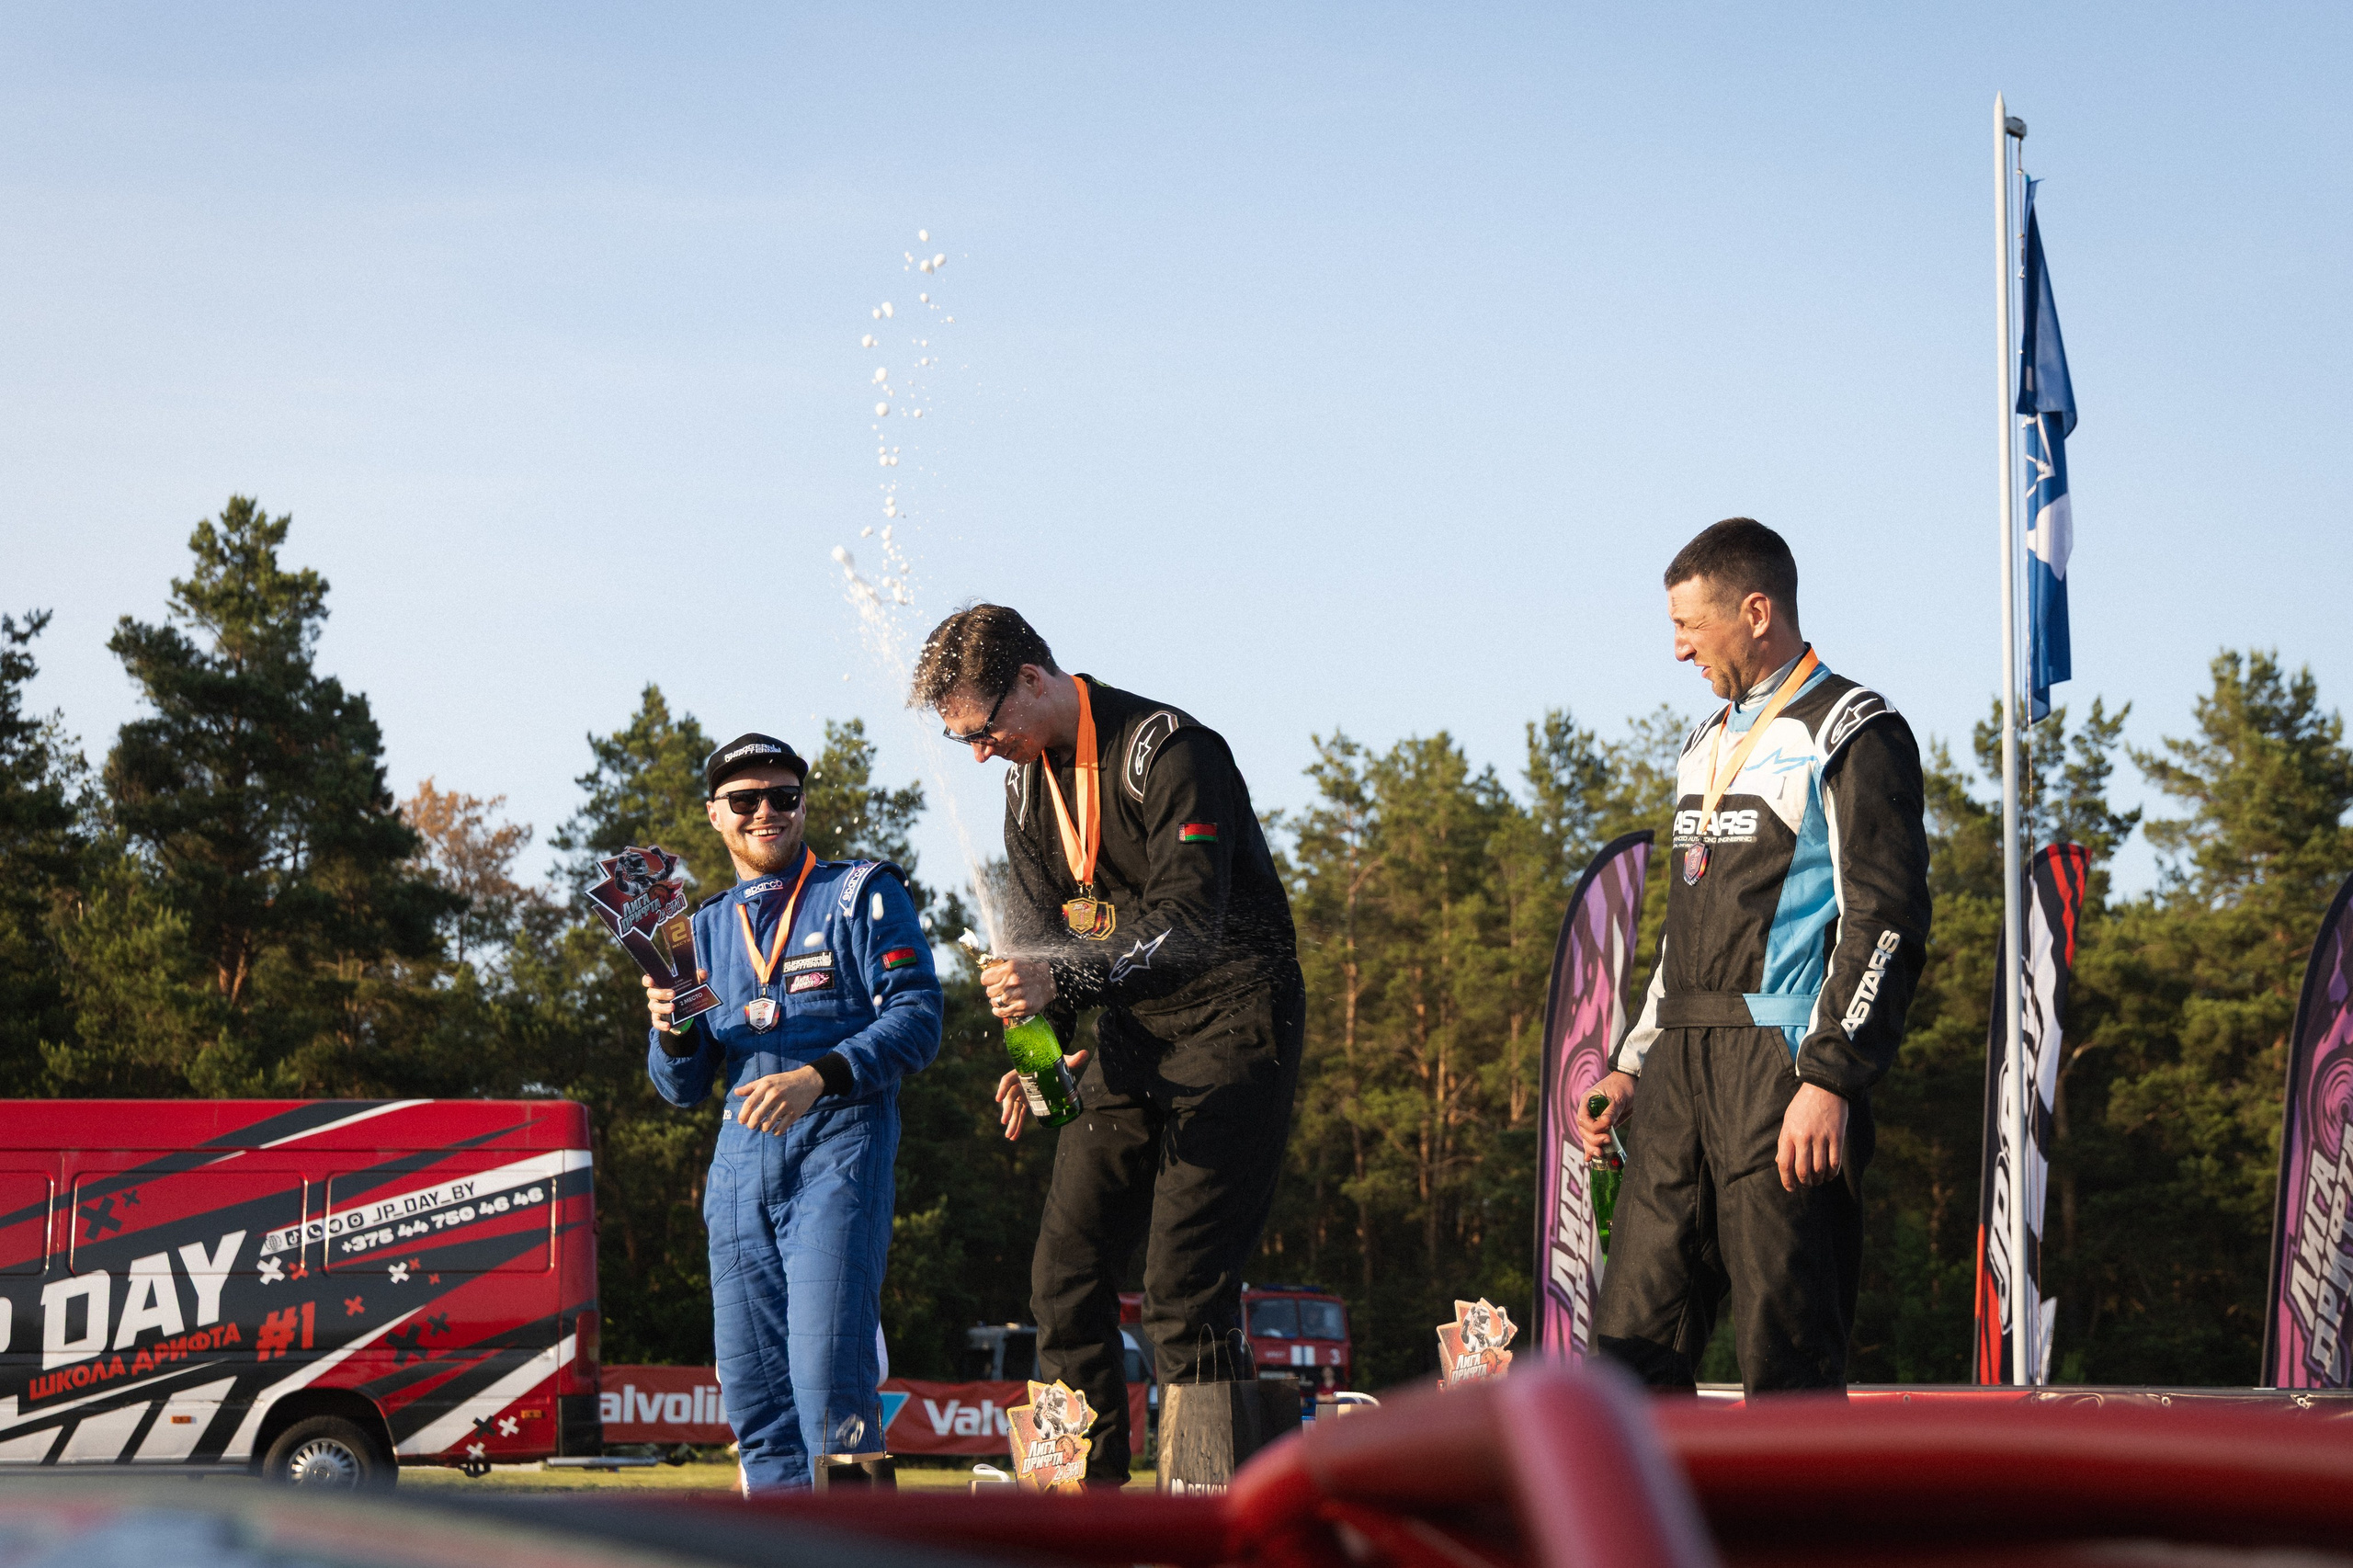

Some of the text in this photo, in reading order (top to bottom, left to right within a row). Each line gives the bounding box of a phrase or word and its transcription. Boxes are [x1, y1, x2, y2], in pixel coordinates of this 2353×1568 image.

[1673, 810, 1758, 836] ASTARS
[745, 880, 783, 897] sparco
[670, 921, 688, 943] 2
[684, 993, 703, 1004] МЕСТО
[1840, 930, 1901, 1040] ASTARS
[341, 1187, 544, 1254] +375 44 750 46 46
[1552, 1140, 1585, 1307] ЛИГА
[2290, 1149, 2336, 1330] ЛИГА
[40, 1230, 247, 1370] DAY
[256, 1301, 315, 1362] #1
[29, 1323, 242, 1401] ШКОЛА ДРИФТА
[1329, 1348, 1341, 1365] 3
[1455, 1353, 1481, 1370] ЛИГА
[599, 1384, 729, 1424] alvoli
[923, 1399, 1012, 1437] Valv
[1022, 1451, 1063, 1473] ДРИФТА
[1028, 1440, 1056, 1458] ЛИГА
